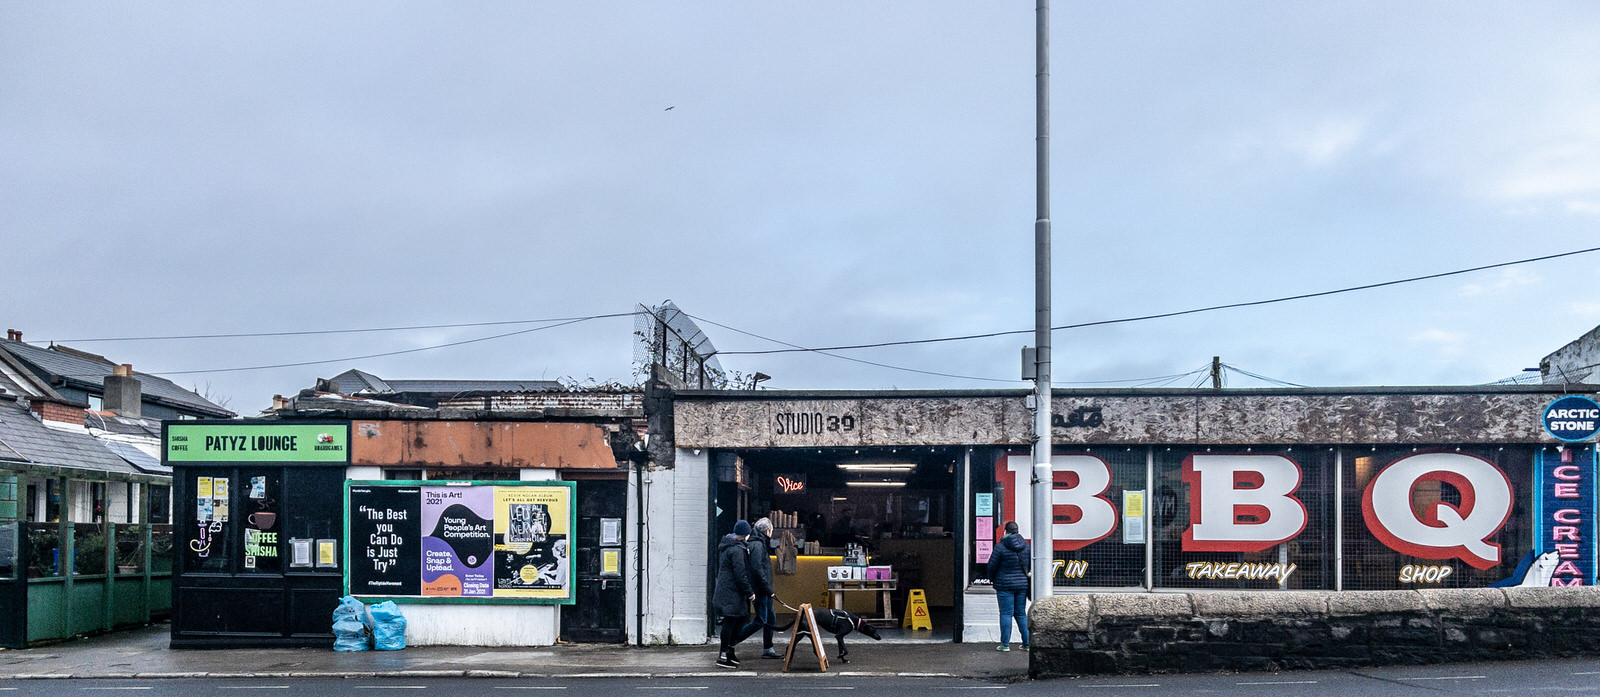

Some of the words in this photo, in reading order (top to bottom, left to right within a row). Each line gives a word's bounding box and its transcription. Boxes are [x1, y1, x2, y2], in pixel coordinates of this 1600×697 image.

[1547, 408, 1600, 419] ARCTIC
[776, 412, 823, 435] STUDIO
[826, 415, 855, 432] 39
[1550, 420, 1595, 431] STONE
[205, 435, 247, 451] PATYZ
[251, 435, 298, 451] LOUNGE
[777, 476, 804, 493] Vice
[449, 491, 463, 499] Art!
[386, 508, 407, 520] Best
[443, 516, 467, 525] Young
[376, 523, 393, 535] you
[443, 524, 474, 533] People's
[443, 530, 491, 539] Competition.
[251, 531, 278, 544] OFFEE
[370, 533, 388, 545] Can
[390, 533, 403, 545] Do
[244, 545, 278, 557] SHISHA
[366, 546, 375, 558] is
[377, 546, 398, 558] Just
[426, 564, 454, 572] Upload.
[1064, 559, 1089, 579] IN
[1186, 561, 1297, 585] TAKEAWAY
[1399, 564, 1453, 583] SHOP
